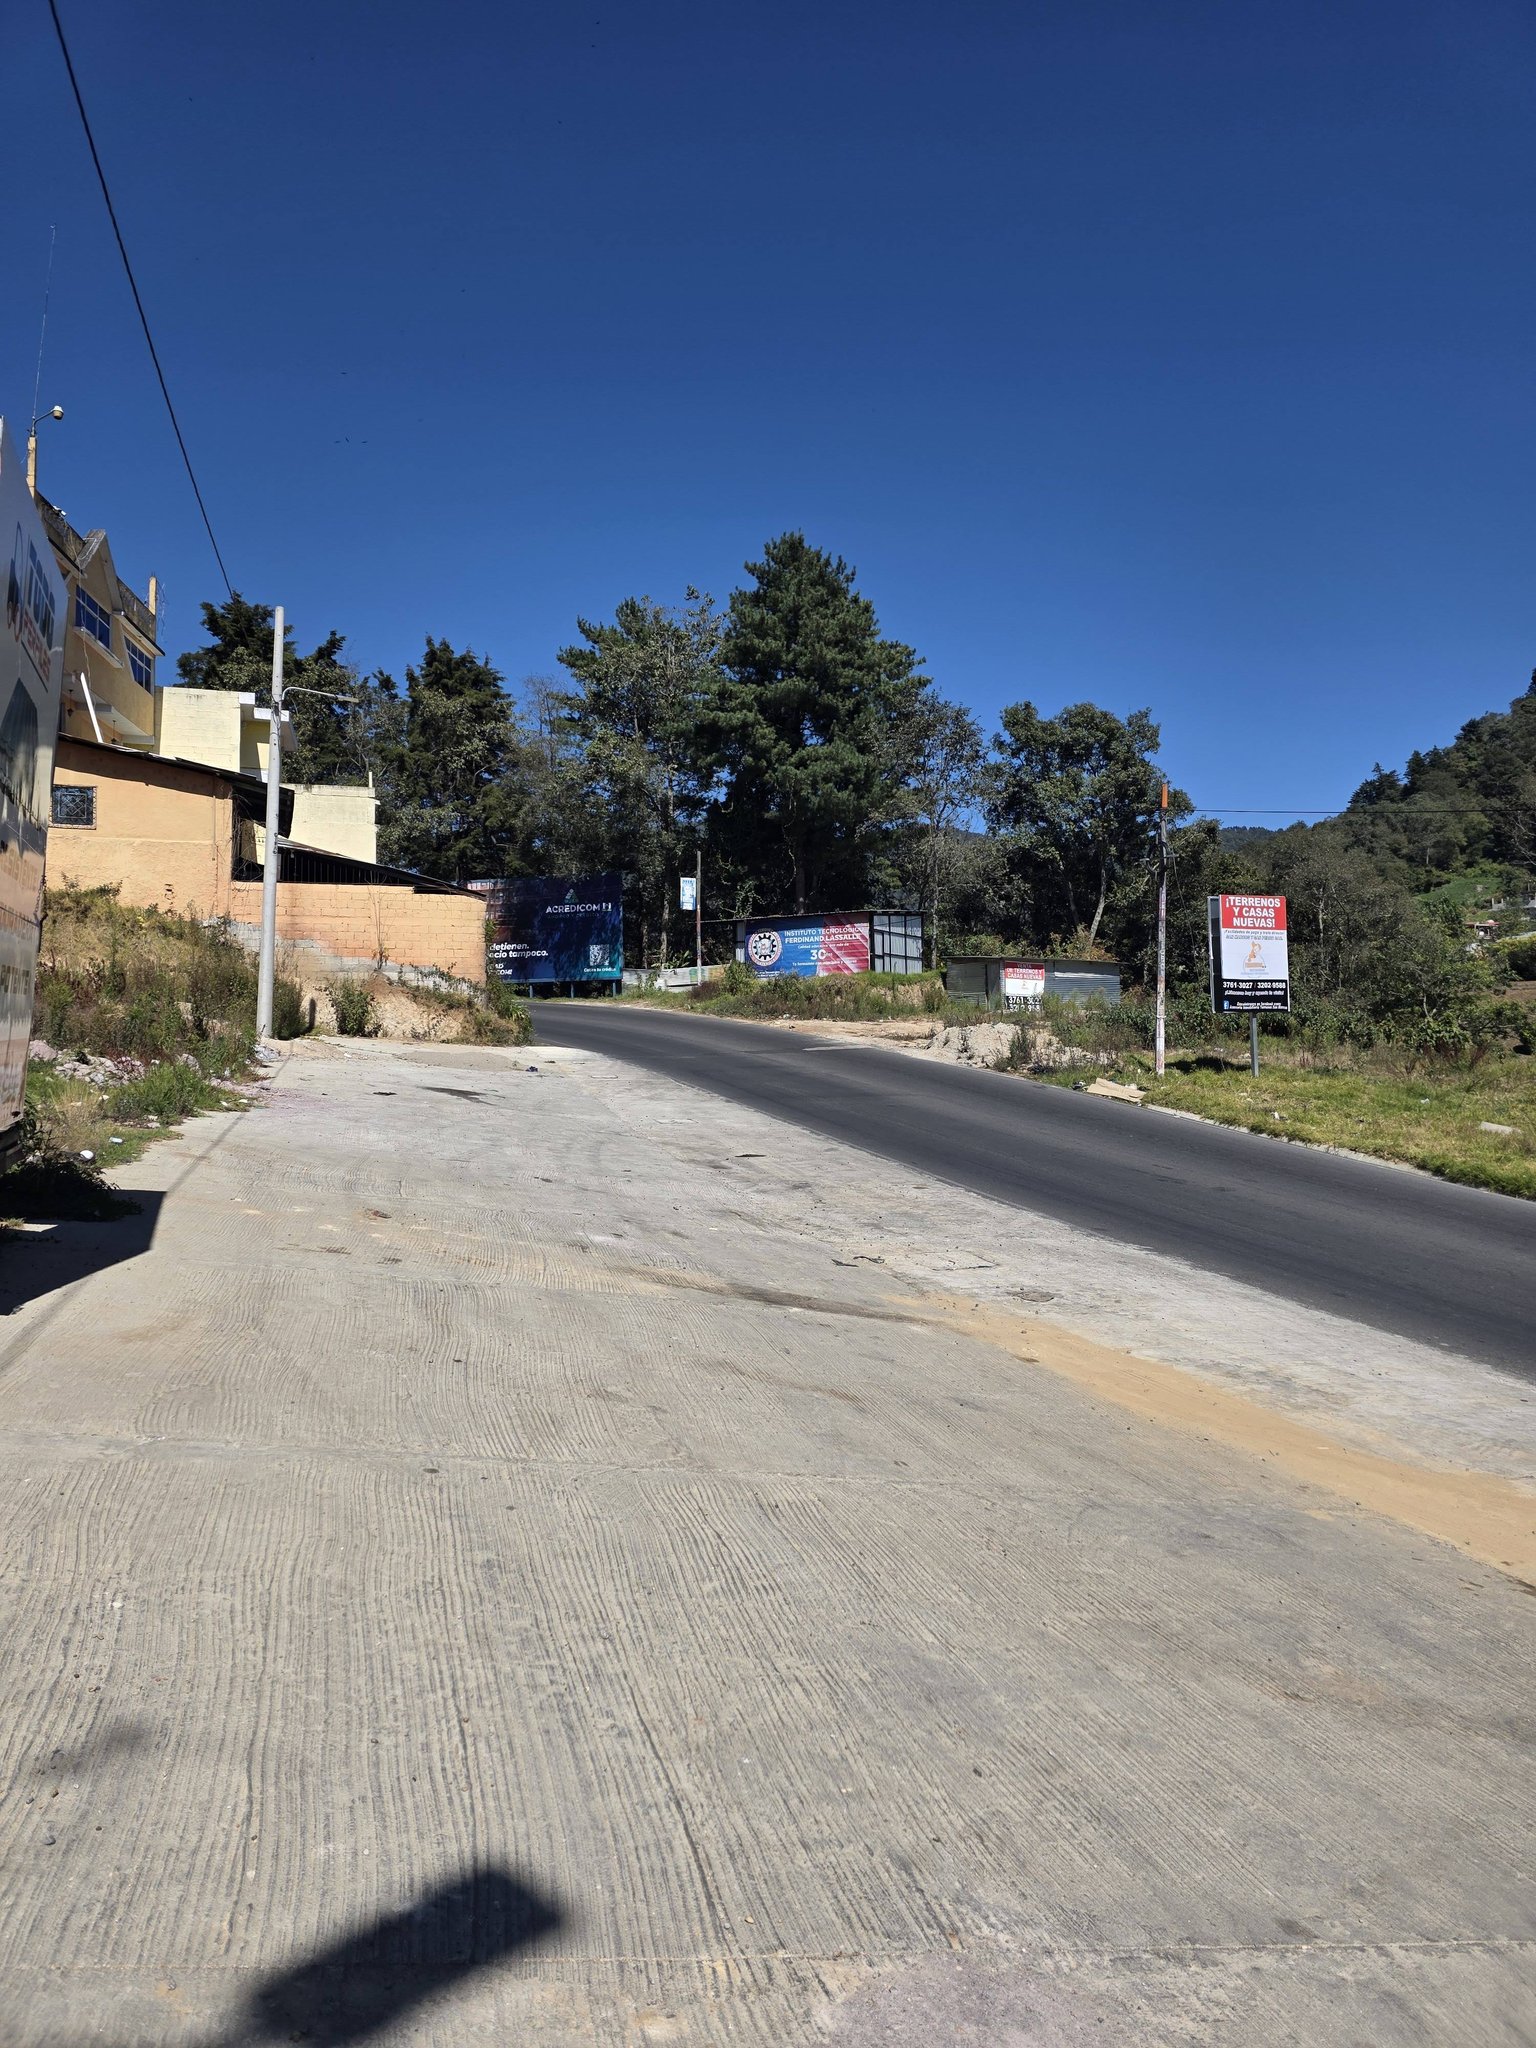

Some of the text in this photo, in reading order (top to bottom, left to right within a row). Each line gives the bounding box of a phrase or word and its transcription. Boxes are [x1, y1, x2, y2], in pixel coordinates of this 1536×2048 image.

[27, 540, 56, 651] TODO
[1226, 896, 1281, 907] ¡TERRENOS
[545, 903, 601, 914] ACREDICOM
[1233, 907, 1275, 917] Y CASAS
[1233, 918, 1275, 927] NUEVAS!
[784, 929, 817, 937] INSTITUTO
[784, 935, 825, 944] FERDINAND
